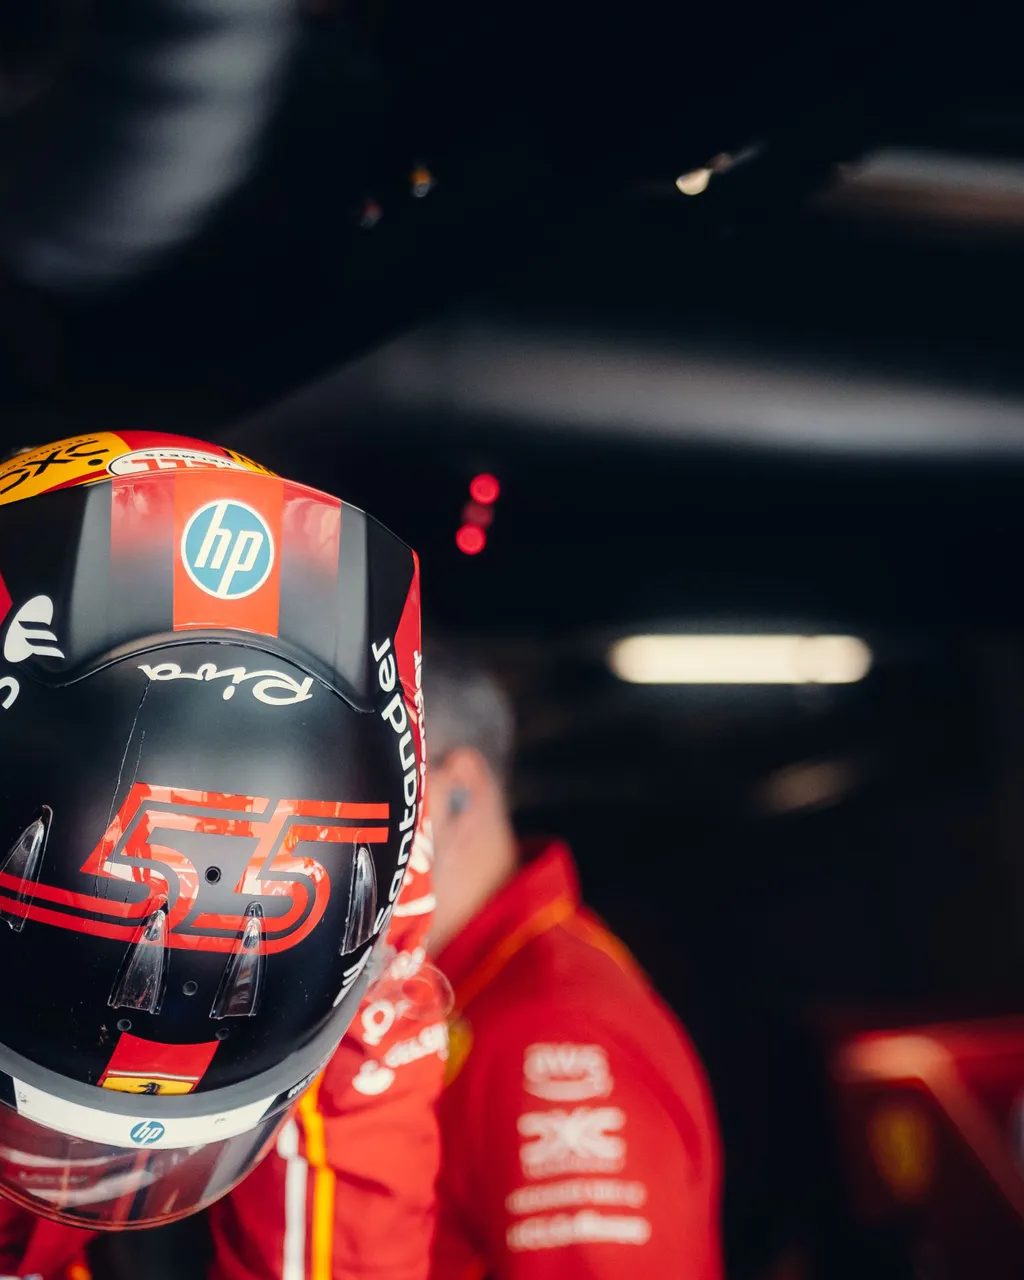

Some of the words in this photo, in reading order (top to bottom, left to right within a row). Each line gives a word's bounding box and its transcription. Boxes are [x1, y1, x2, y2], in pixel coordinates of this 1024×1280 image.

[190, 499, 266, 599] hp
[137, 663, 314, 706] Riva
[131, 1120, 164, 1145] hp
